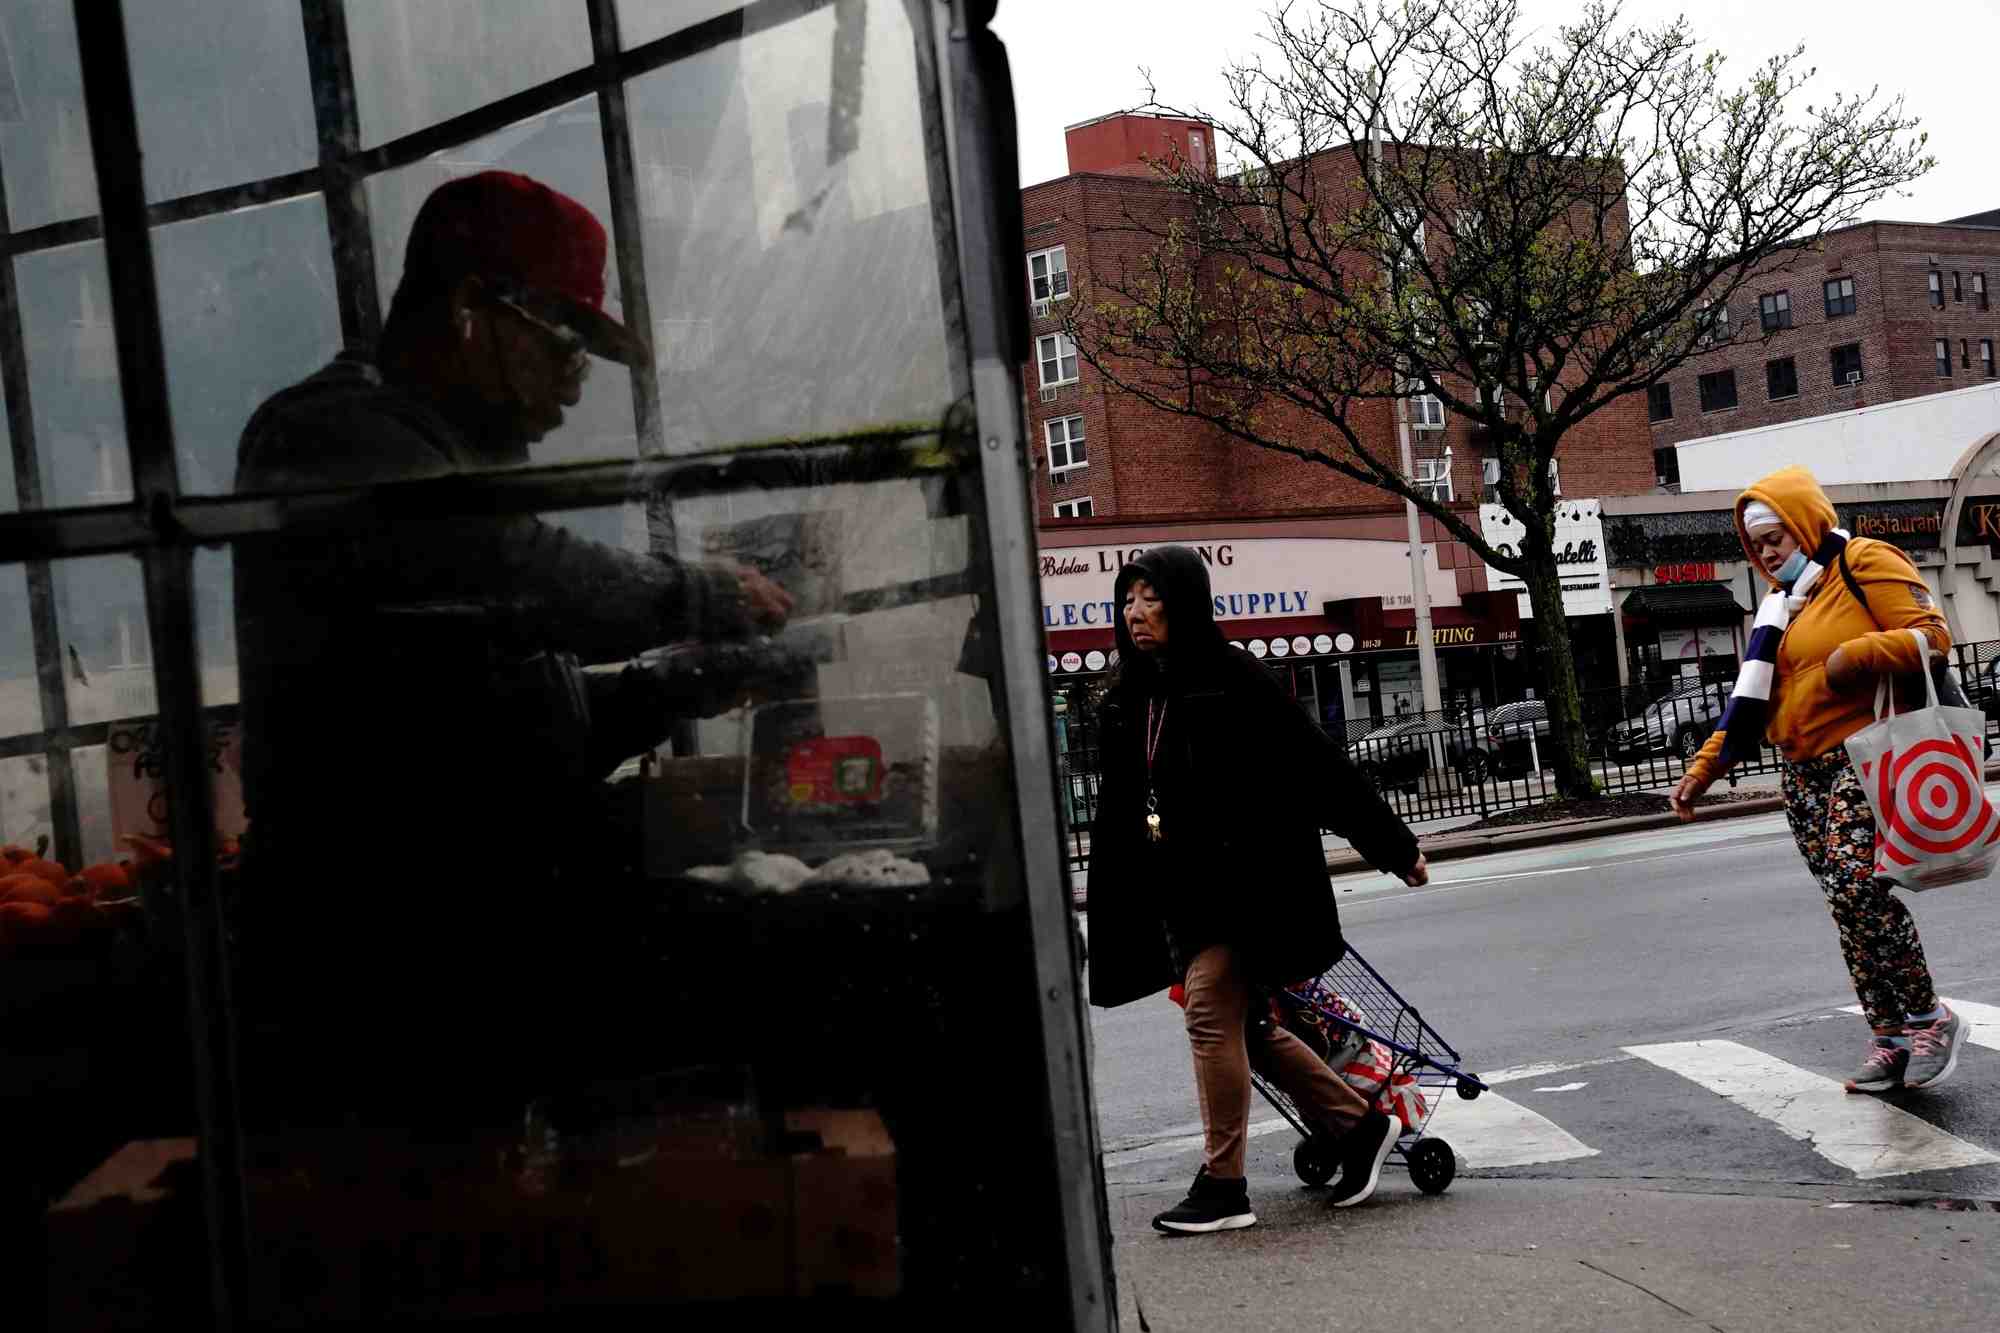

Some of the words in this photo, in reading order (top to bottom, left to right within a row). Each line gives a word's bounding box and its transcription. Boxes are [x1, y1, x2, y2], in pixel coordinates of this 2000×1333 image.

[1856, 511, 1942, 535] Restaurant
[1654, 560, 1716, 586] SUSHI
[1214, 590, 1309, 617] SUPPLY
[1405, 626, 1475, 646] LIHTING
